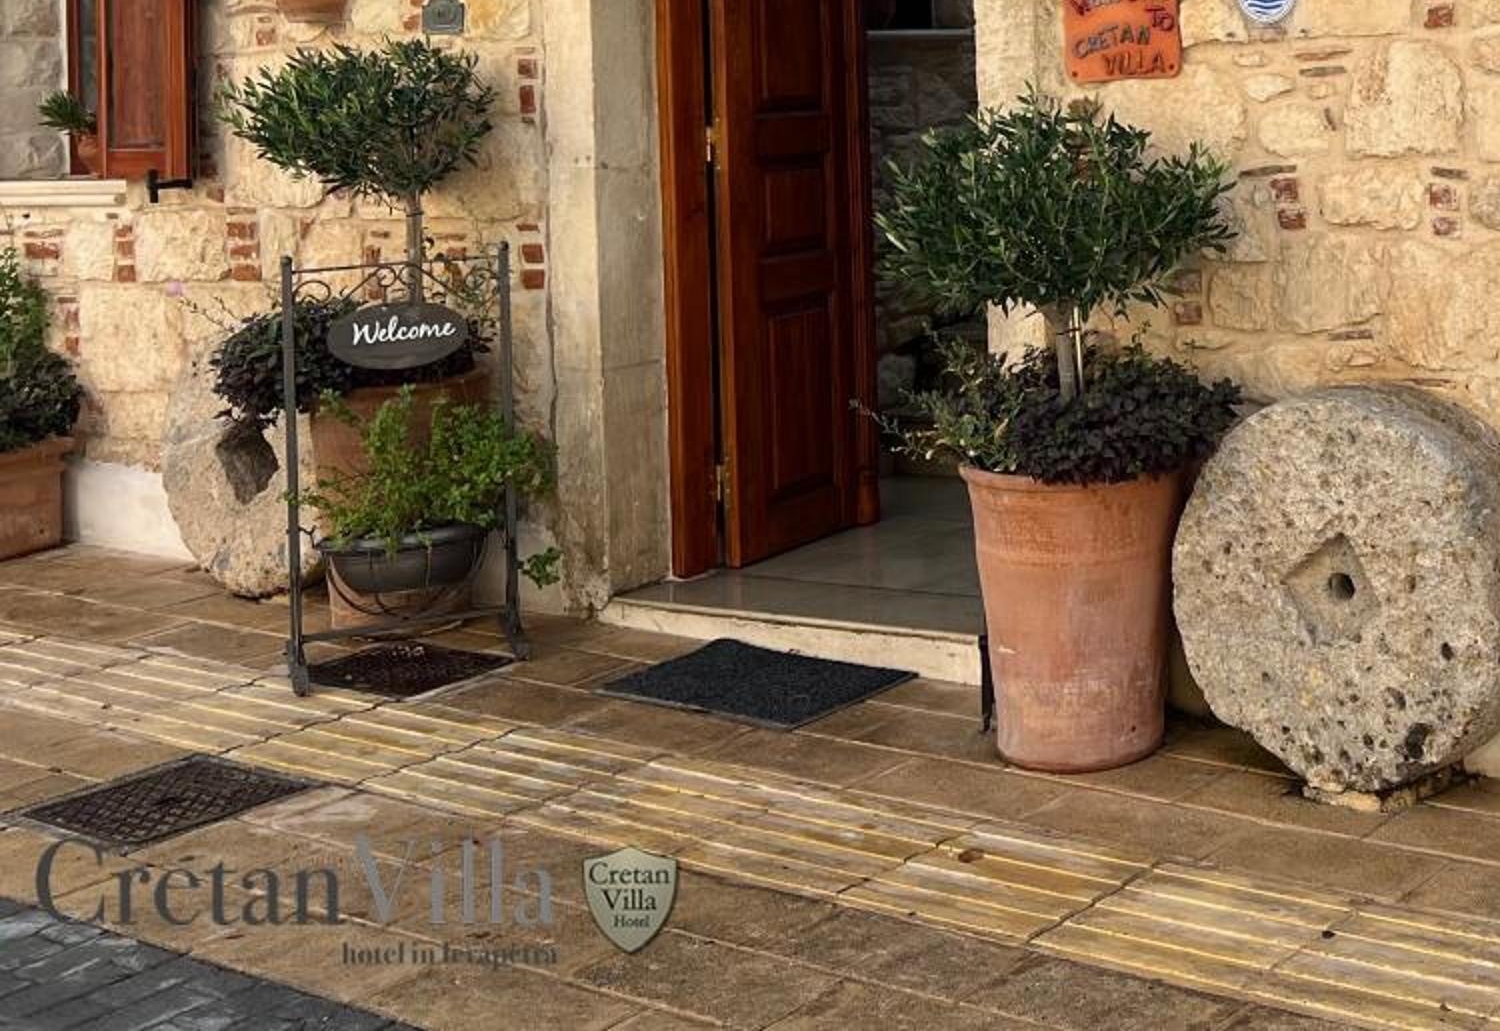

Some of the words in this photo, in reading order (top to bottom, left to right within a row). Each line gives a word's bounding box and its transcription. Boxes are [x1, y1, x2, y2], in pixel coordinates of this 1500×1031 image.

[1072, 24, 1151, 59] CRETAN
[1101, 50, 1166, 76] VILLA
[352, 315, 457, 346] Welcome
